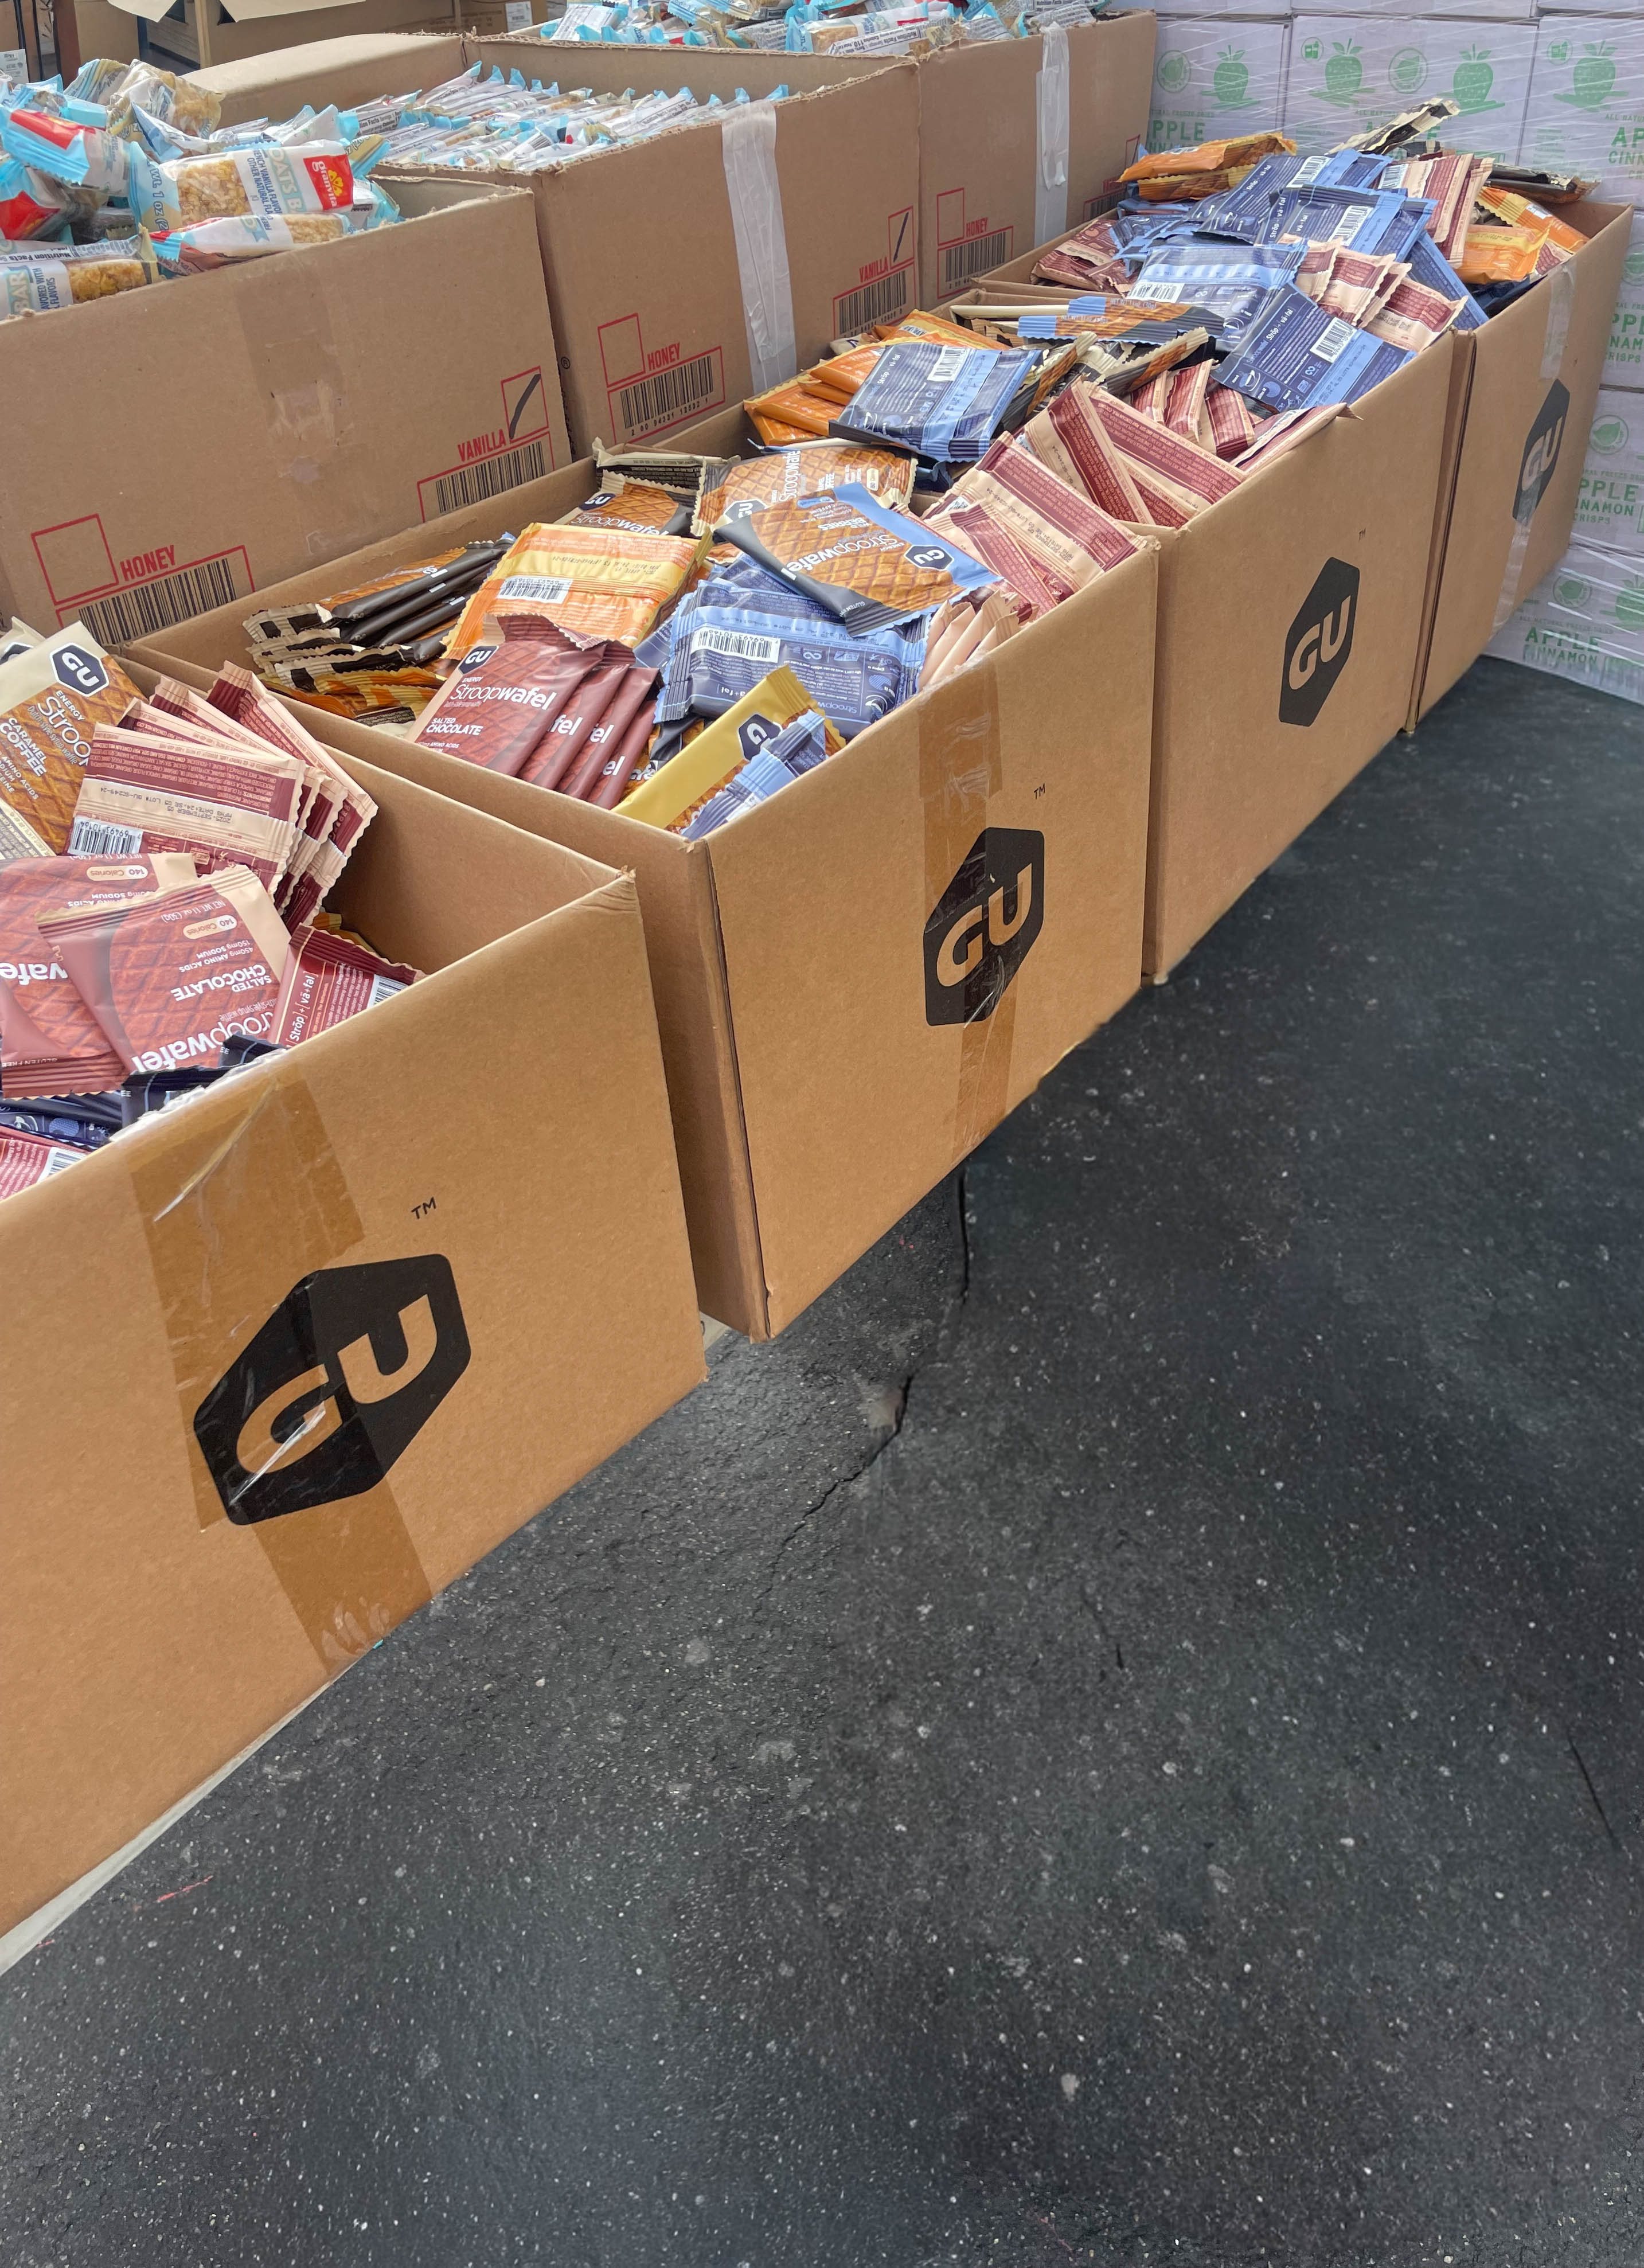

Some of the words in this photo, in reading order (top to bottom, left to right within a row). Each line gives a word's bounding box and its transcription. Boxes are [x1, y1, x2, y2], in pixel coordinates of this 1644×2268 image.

[1152, 119, 1206, 142] PPLE
[247, 158, 260, 178] OTHER
[254, 176, 268, 205] NATURAL
[261, 167, 274, 196] VANILLA
[312, 160, 338, 208] granvita
[966, 217, 988, 233] HONEY
[32, 267, 45, 284] WITH
[859, 256, 888, 283] VANILLA
[647, 342, 681, 371] HONEY
[1608, 352, 1642, 363] RISPS
[458, 429, 506, 462] VANILLA
[1521, 416, 1564, 491] GU
[1580, 478, 1639, 502] PPLE
[817, 517, 866, 531] BERRIES
[119, 544, 175, 581] HONEY
[780, 534, 898, 581] Stroopwafel
[913, 549, 945, 565] GU
[738, 634, 764, 643] 69493
[1288, 595, 1351, 690] GU
[465, 650, 491, 665] GU
[62, 651, 100, 687] GU
[56, 690, 85, 721] ENERGY
[450, 684, 557, 711] Stroopwafel
[816, 699, 857, 714] Stroopw
[426, 724, 484, 736] CHOCOLATE
[0, 723, 47, 777] COFFEE
[9, 717, 48, 764] CARAMEL
[61, 747, 77, 766] waffle
[2, 755, 22, 779] AMINO
[21, 778, 39, 800] ACIDS
[1033, 783, 1046, 800] TM
[80, 821, 101, 832] 10164
[106, 826, 130, 839] 69493
[89, 868, 124, 877] Calories
[128, 868, 145, 876] 140
[186, 922, 217, 936] Calories
[217, 918, 235, 927] 140
[936, 862, 1032, 987] GU
[196, 946, 227, 959] SODIUM
[226, 939, 251, 950] 150mg
[228, 946, 254, 958] 450mg
[178, 962, 202, 973] ACIDS
[204, 953, 228, 966] AMINO
[170, 964, 267, 1001] CHOCOLATE
[231, 975, 272, 993] SALTED
[411, 1197, 437, 1220] TM
[236, 1294, 438, 1474] GU
